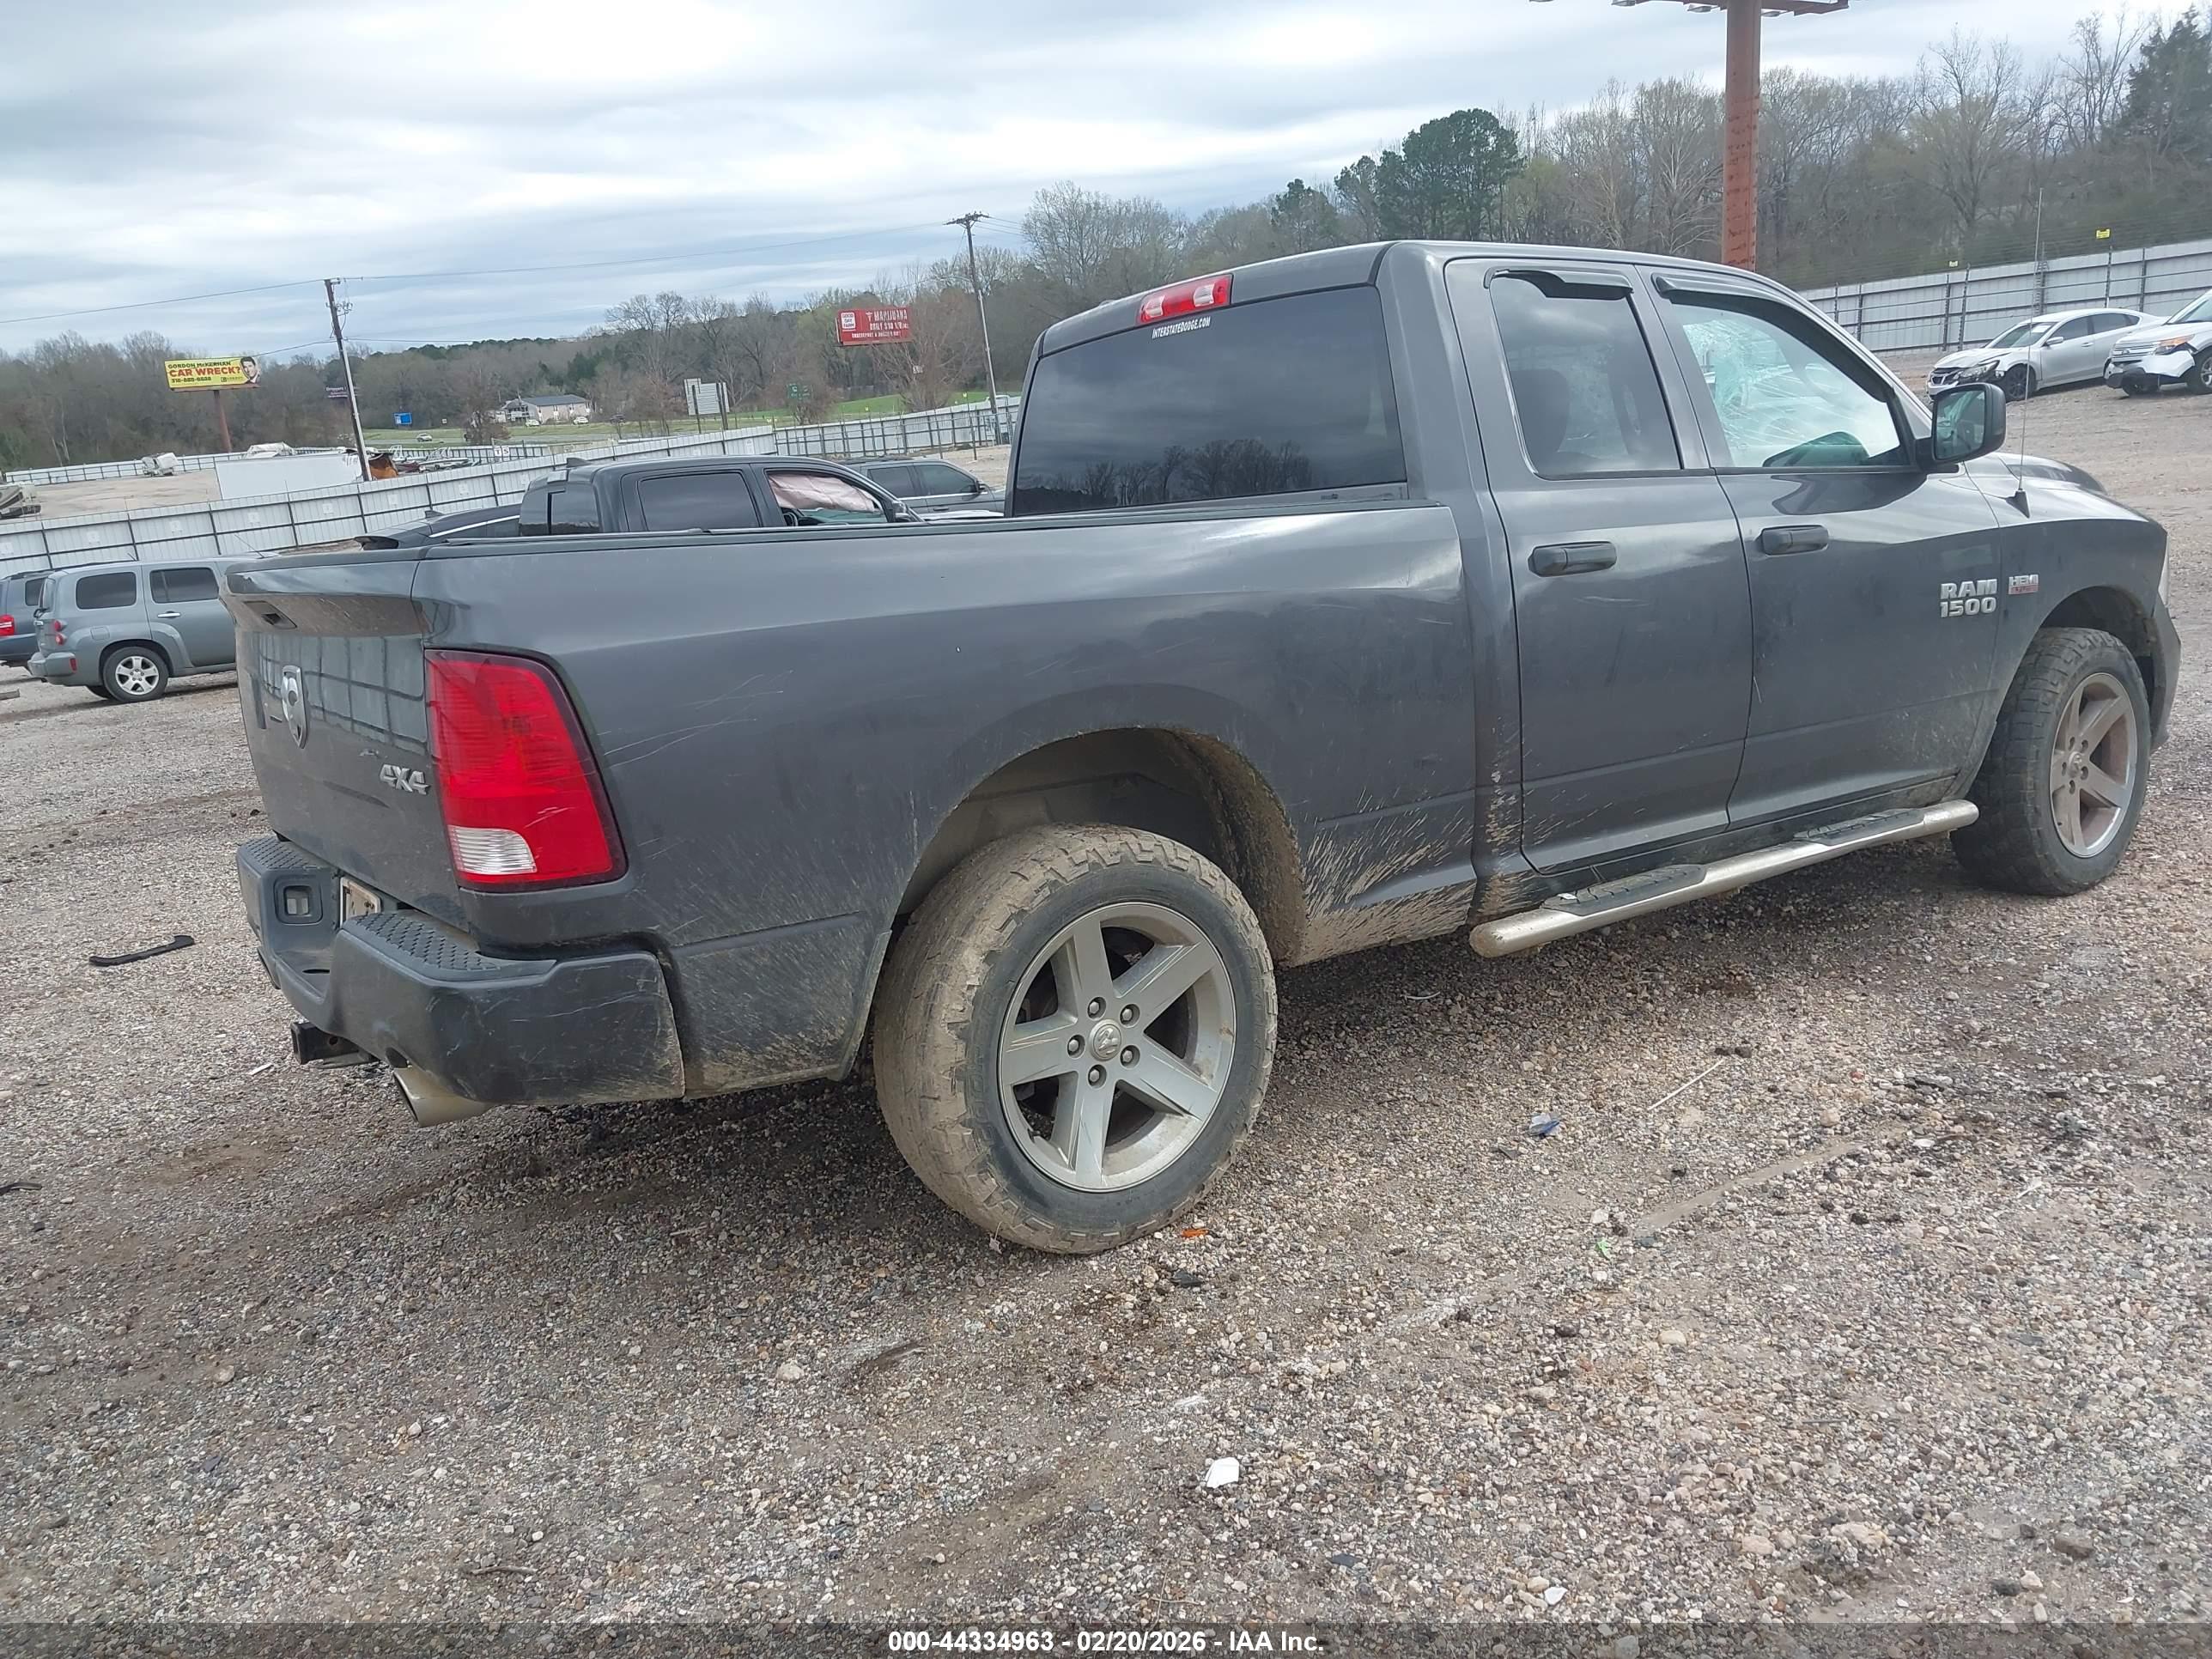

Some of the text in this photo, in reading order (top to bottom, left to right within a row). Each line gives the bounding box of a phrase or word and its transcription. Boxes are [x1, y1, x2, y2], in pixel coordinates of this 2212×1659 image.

[873, 309, 908, 322] MARIJUANA
[169, 366, 240, 377] CAR WRECK?
[2008, 574, 2039, 586] HEMI
[1940, 579, 1997, 599] RAM
[1940, 597, 1997, 618] 1500
